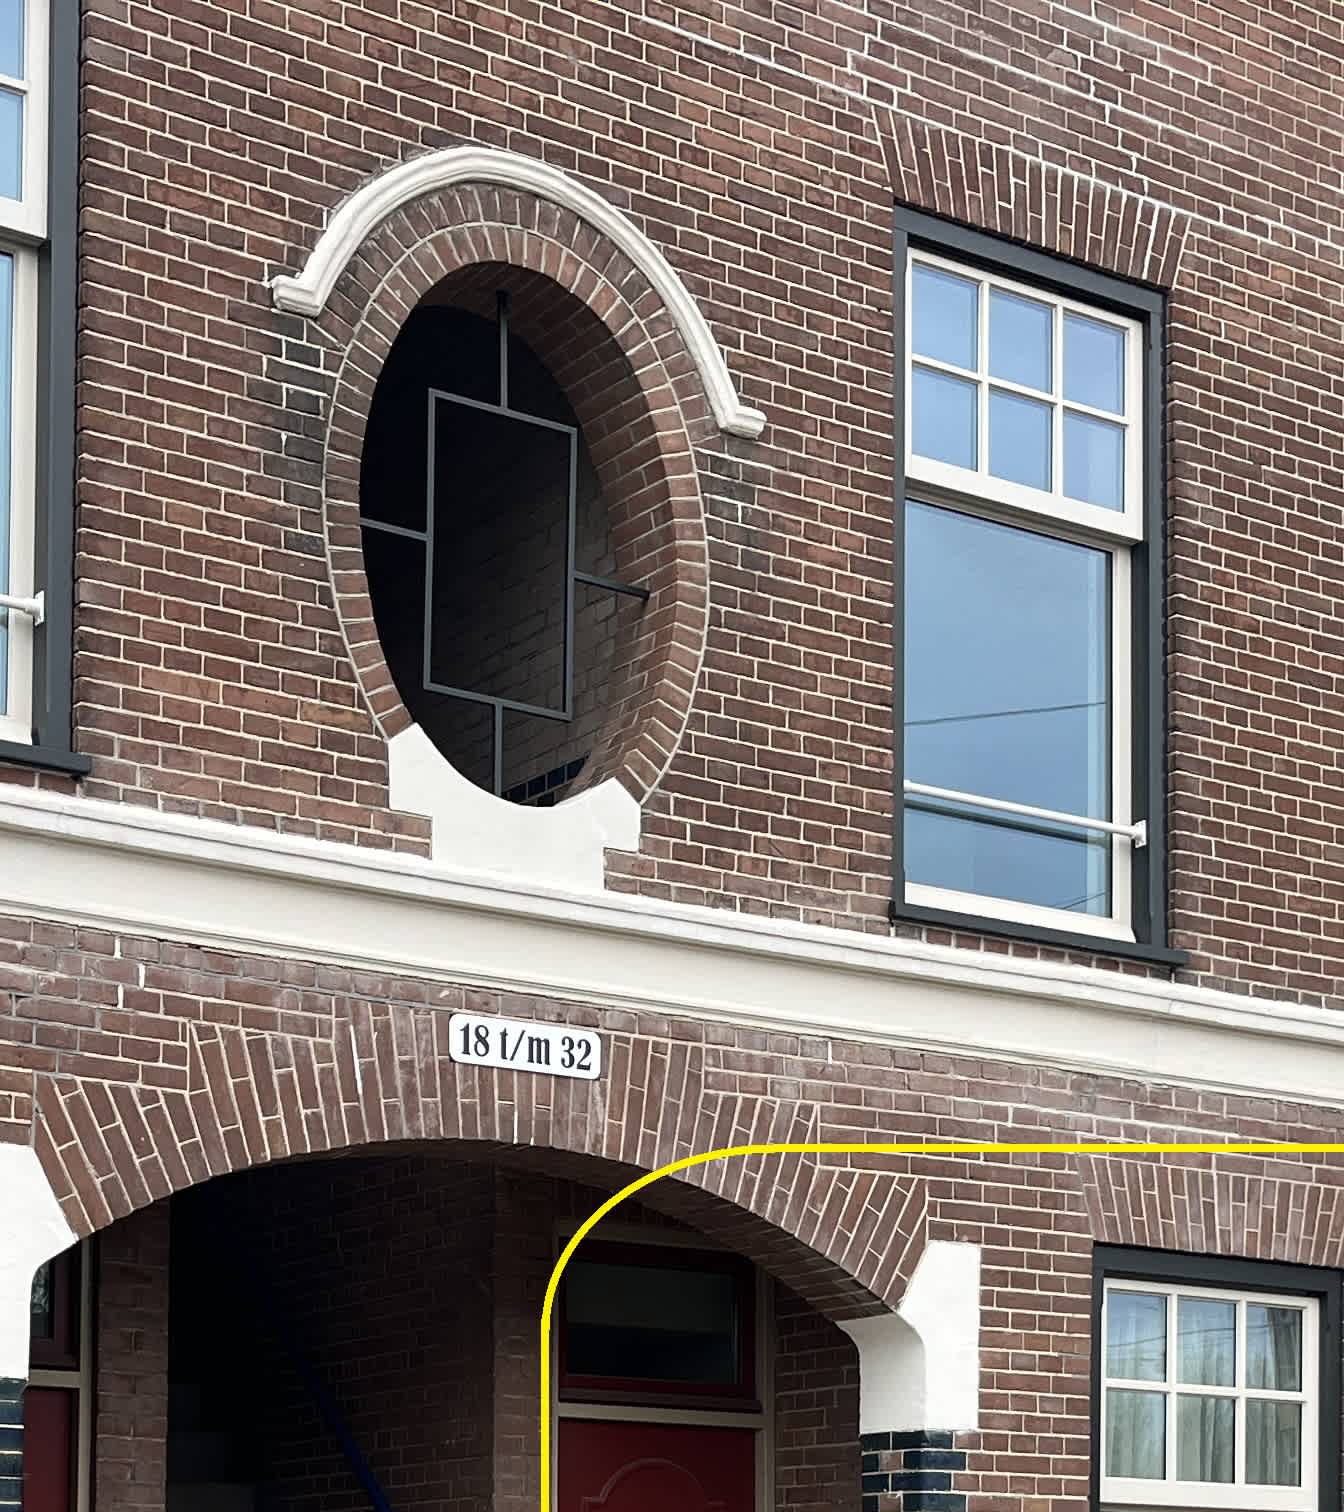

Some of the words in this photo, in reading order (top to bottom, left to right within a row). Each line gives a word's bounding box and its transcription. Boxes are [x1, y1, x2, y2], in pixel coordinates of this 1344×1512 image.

[459, 1022, 490, 1057] 18
[499, 1027, 551, 1066] t/m
[560, 1035, 592, 1071] 32
